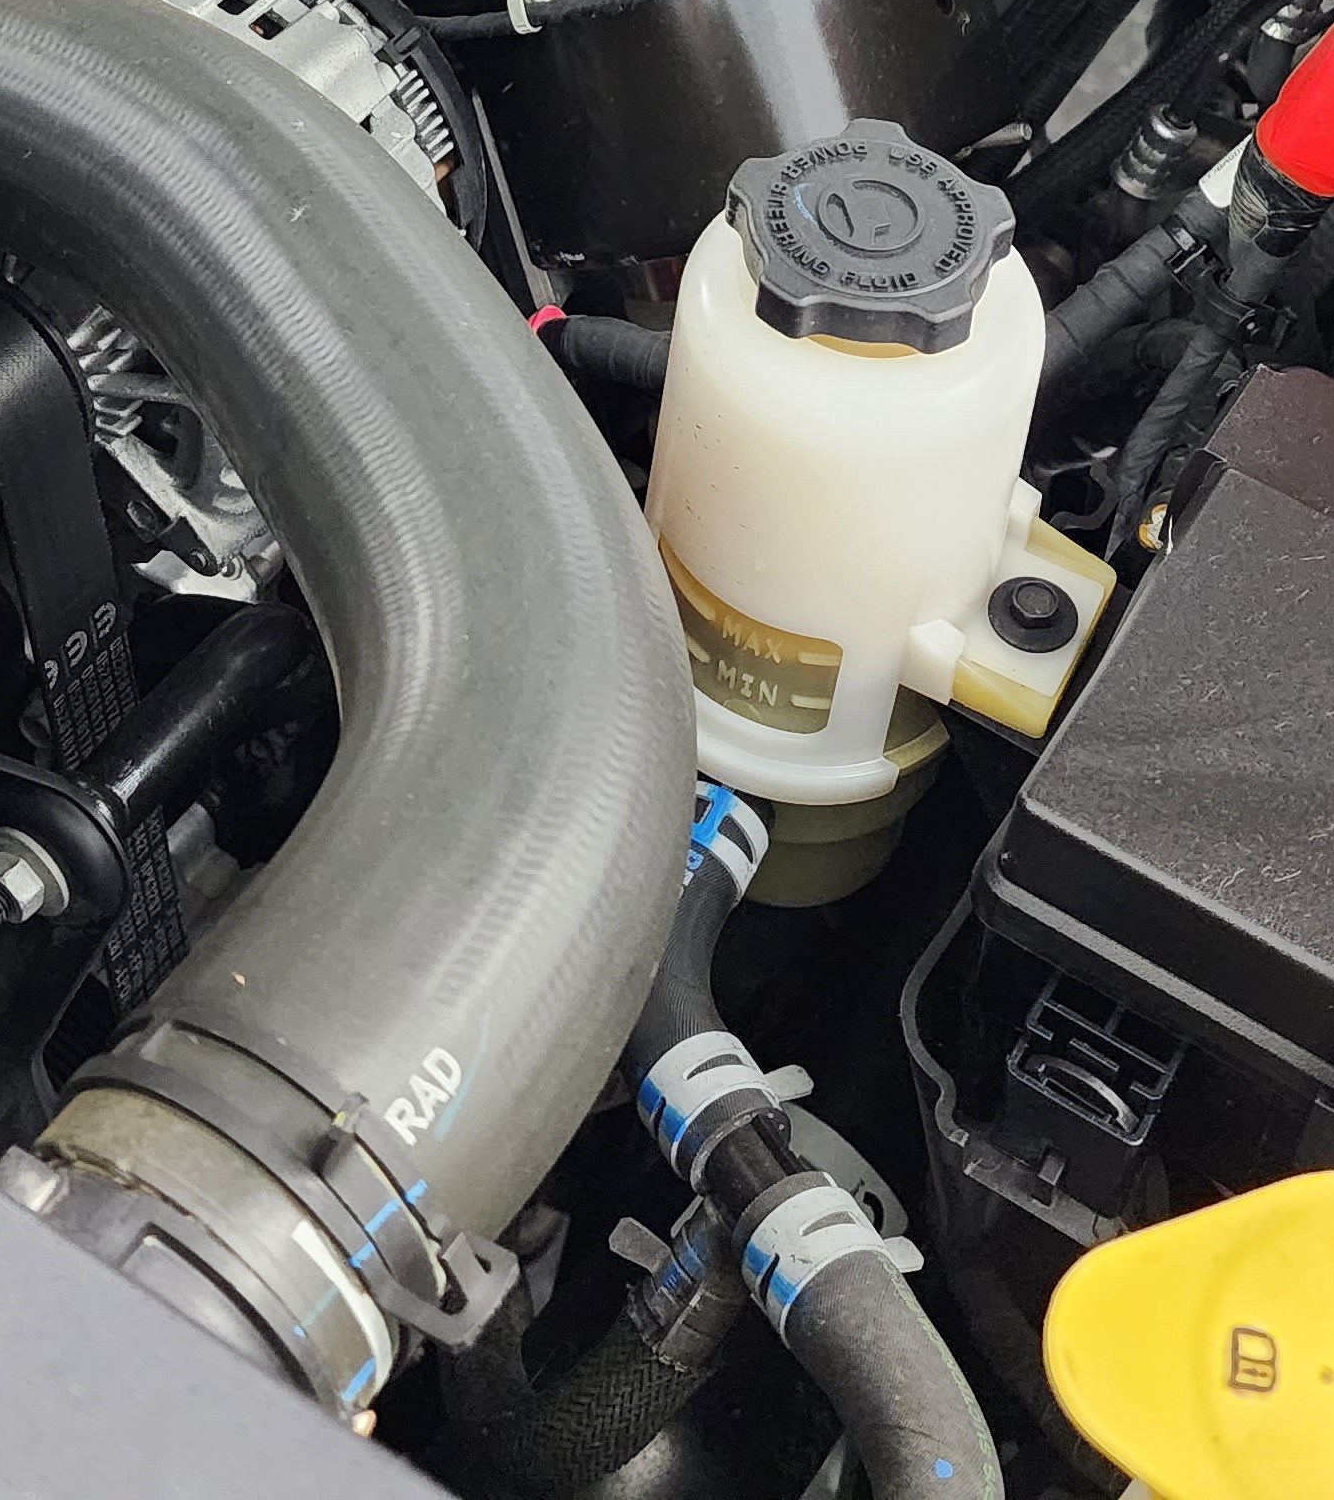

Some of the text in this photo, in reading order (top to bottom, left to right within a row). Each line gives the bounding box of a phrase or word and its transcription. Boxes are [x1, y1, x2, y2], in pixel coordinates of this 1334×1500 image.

[781, 140, 869, 183] POWER
[767, 181, 833, 278] STEERING
[888, 145, 977, 277] USE APPROVED
[722, 615, 784, 664] MAX
[717, 659, 779, 708] MIN
[384, 1047, 462, 1147] RAD
